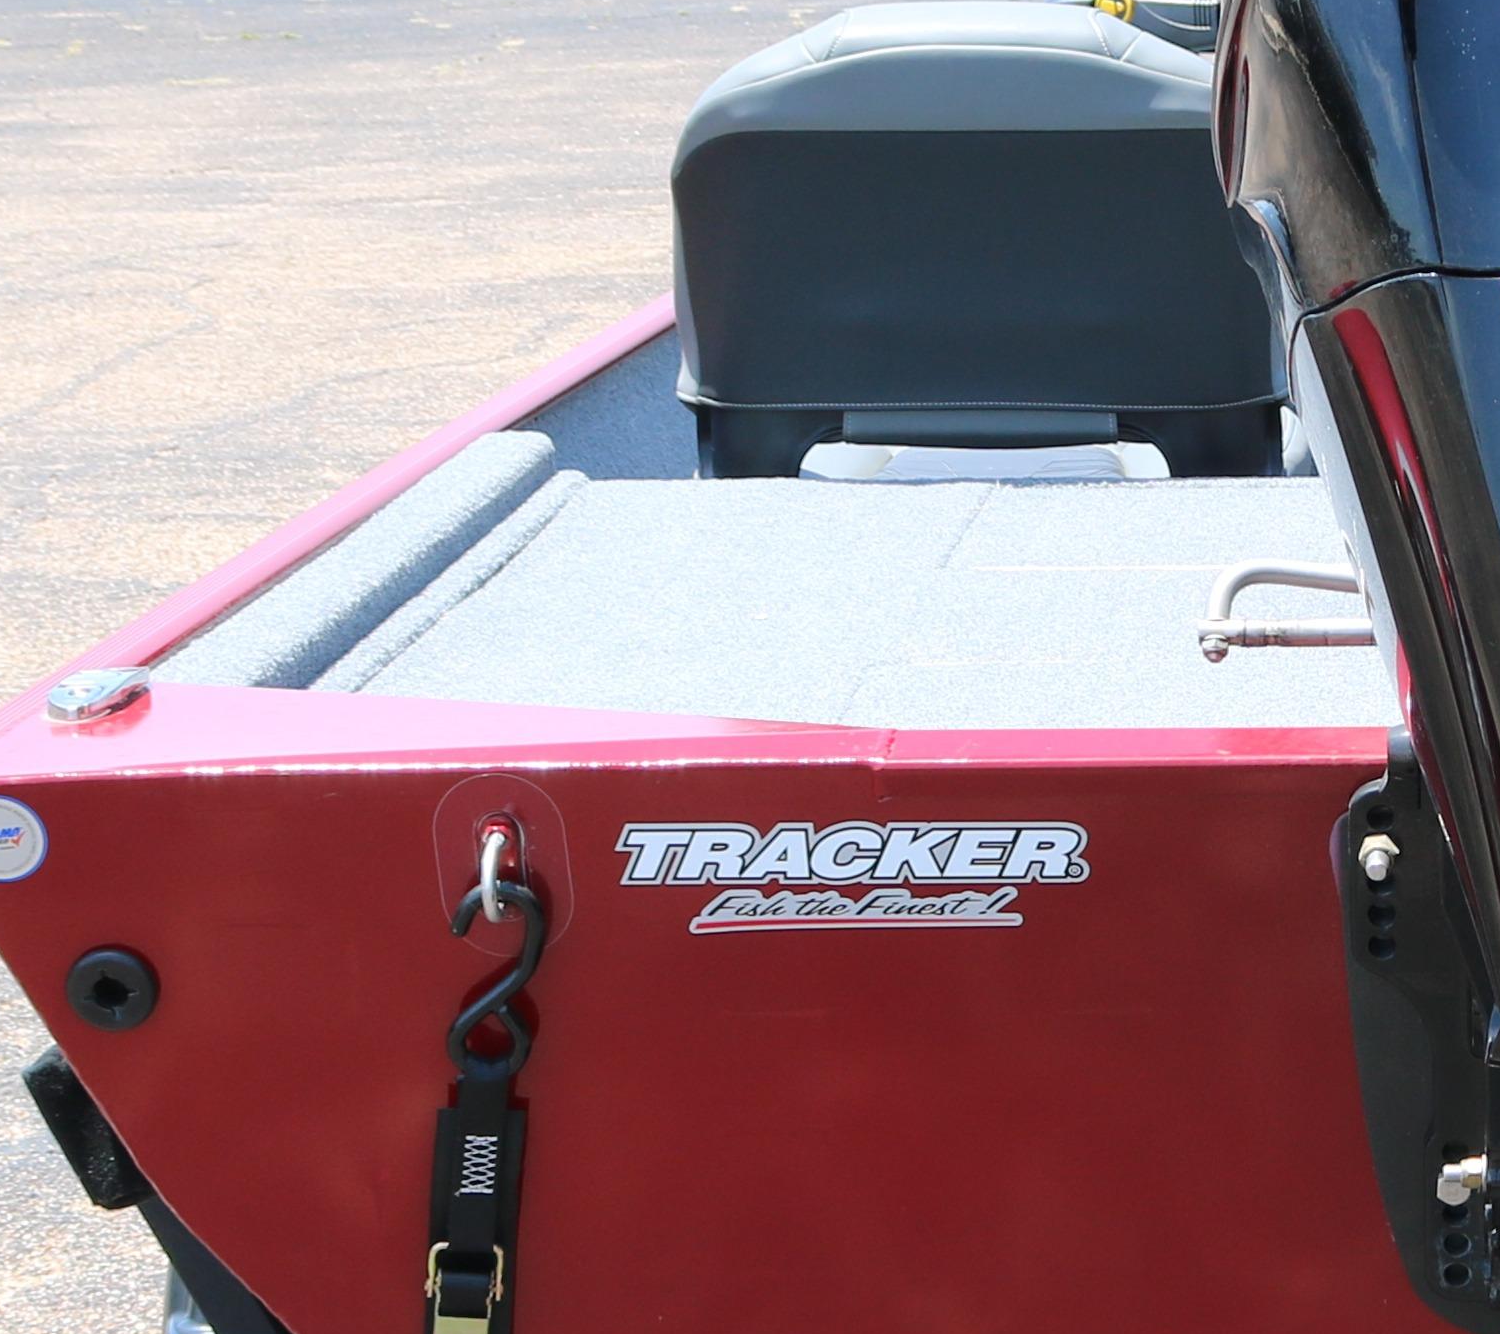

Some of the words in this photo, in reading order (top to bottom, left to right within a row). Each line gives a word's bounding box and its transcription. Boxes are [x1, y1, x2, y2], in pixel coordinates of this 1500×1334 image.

[620, 828, 1075, 882] TRACKER
[709, 895, 788, 918] Fish
[795, 893, 851, 918] the
